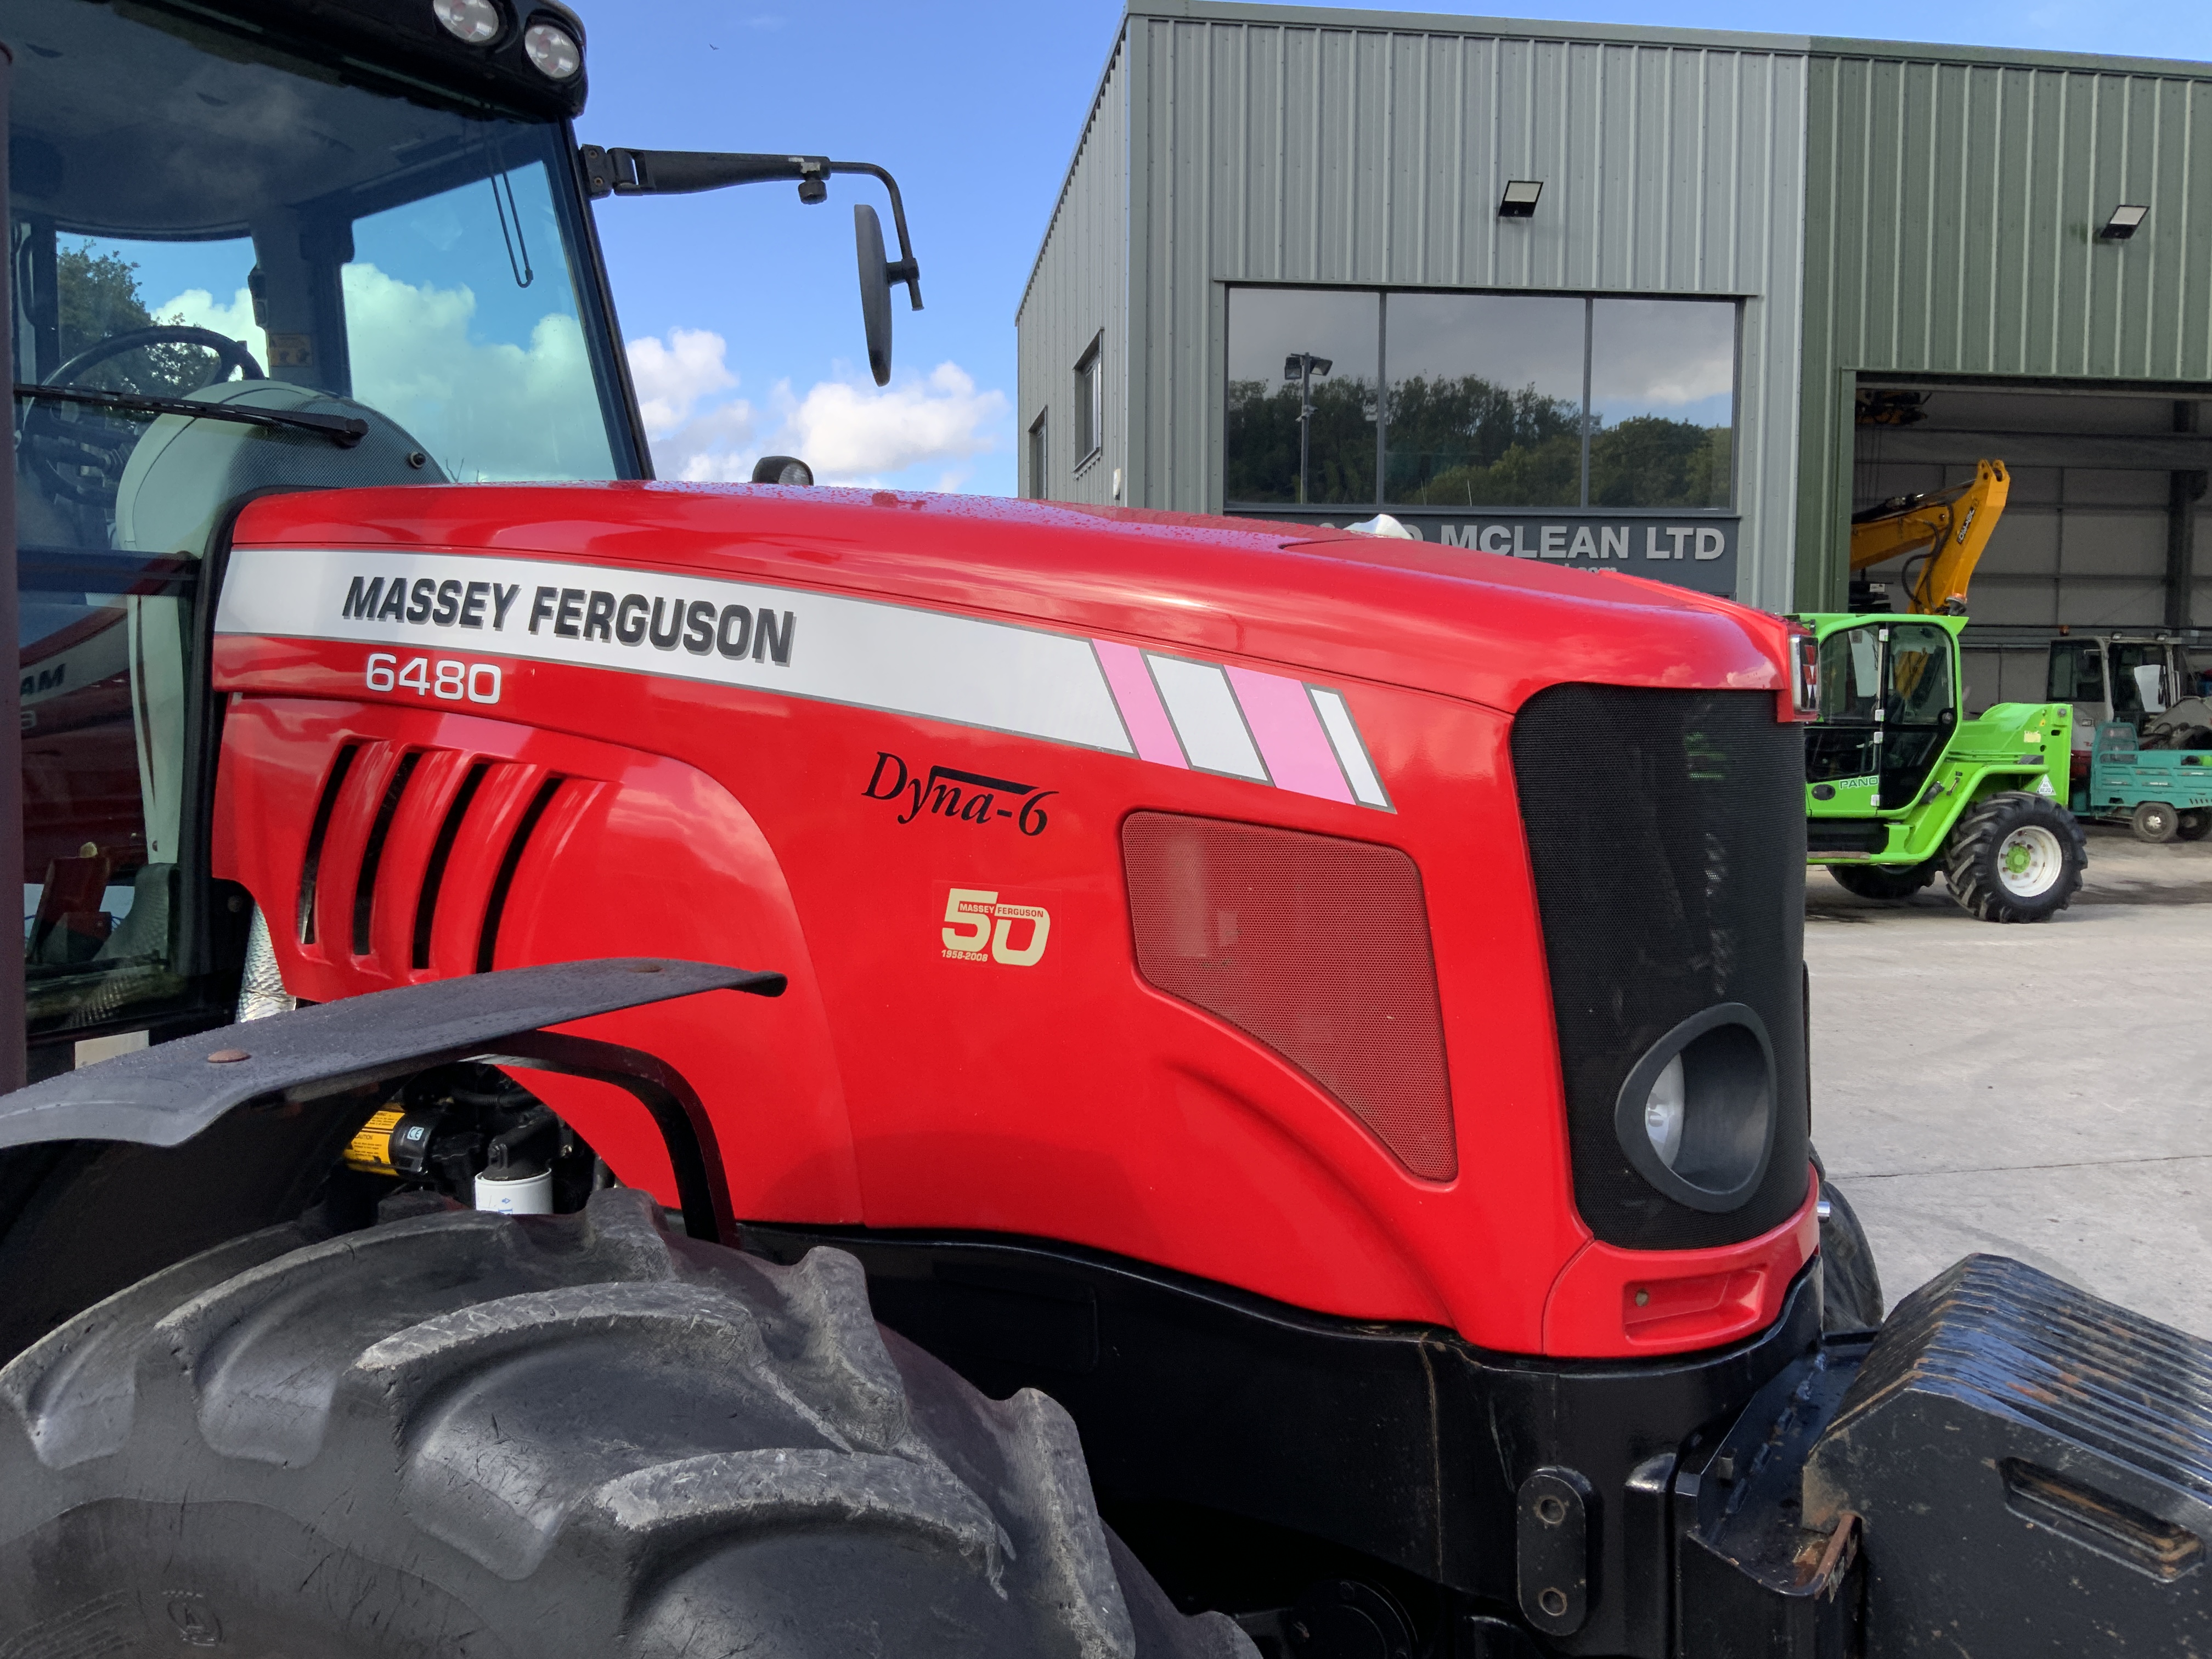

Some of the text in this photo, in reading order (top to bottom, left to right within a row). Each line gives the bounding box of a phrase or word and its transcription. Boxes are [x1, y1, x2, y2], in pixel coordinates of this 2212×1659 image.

[1441, 524, 1629, 560] MCLEAN
[1646, 527, 1726, 561] LTD
[342, 576, 797, 667] MASSEY FERGUSON
[365, 652, 503, 704] 6480
[861, 751, 1059, 837] Dyna-6
[941, 888, 1051, 967] 50
[960, 903, 1044, 918] MASSEY FERGUSON
[941, 949, 989, 962] 1958-2008
